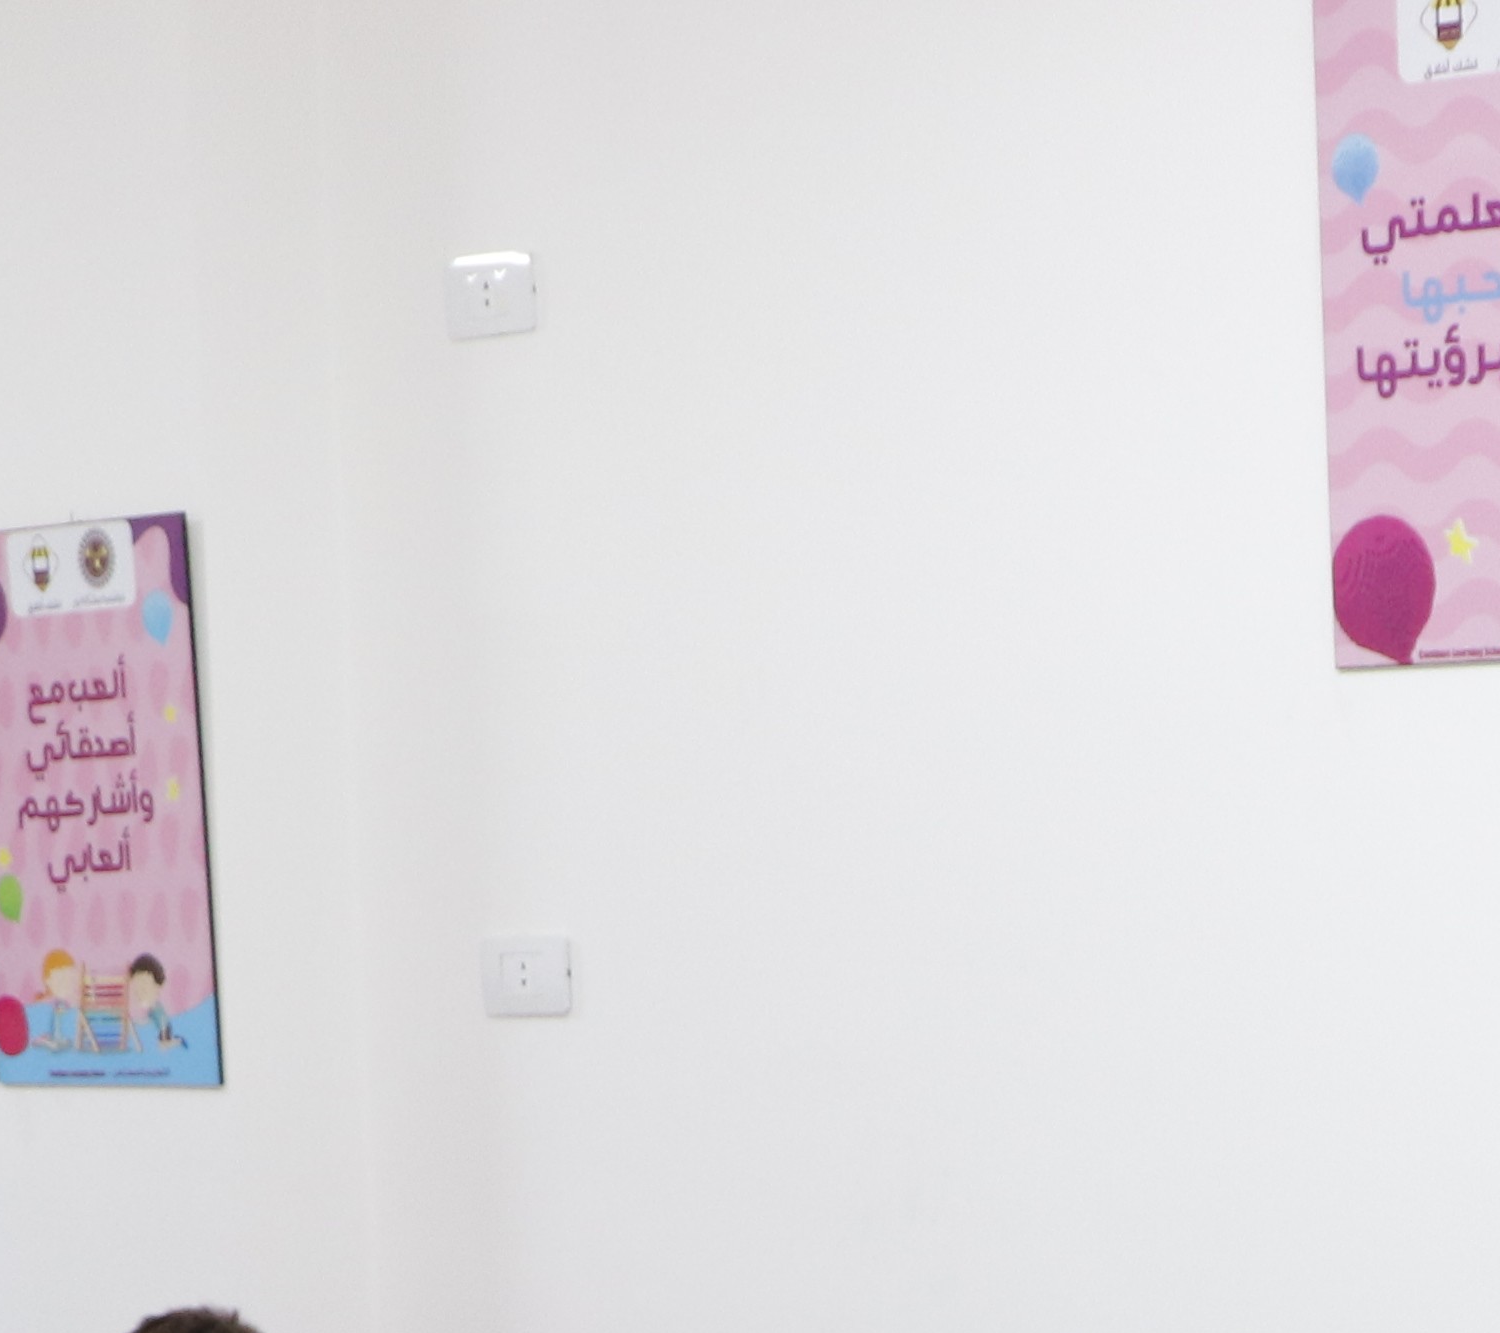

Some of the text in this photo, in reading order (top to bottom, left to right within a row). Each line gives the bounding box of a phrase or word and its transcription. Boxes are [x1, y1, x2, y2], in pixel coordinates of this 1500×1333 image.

[28, 653, 127, 725] ألعب مع
[25, 710, 136, 782] أصدقائي
[19, 769, 155, 834] وأشاركهم
[47, 826, 132, 894] ألعابي
